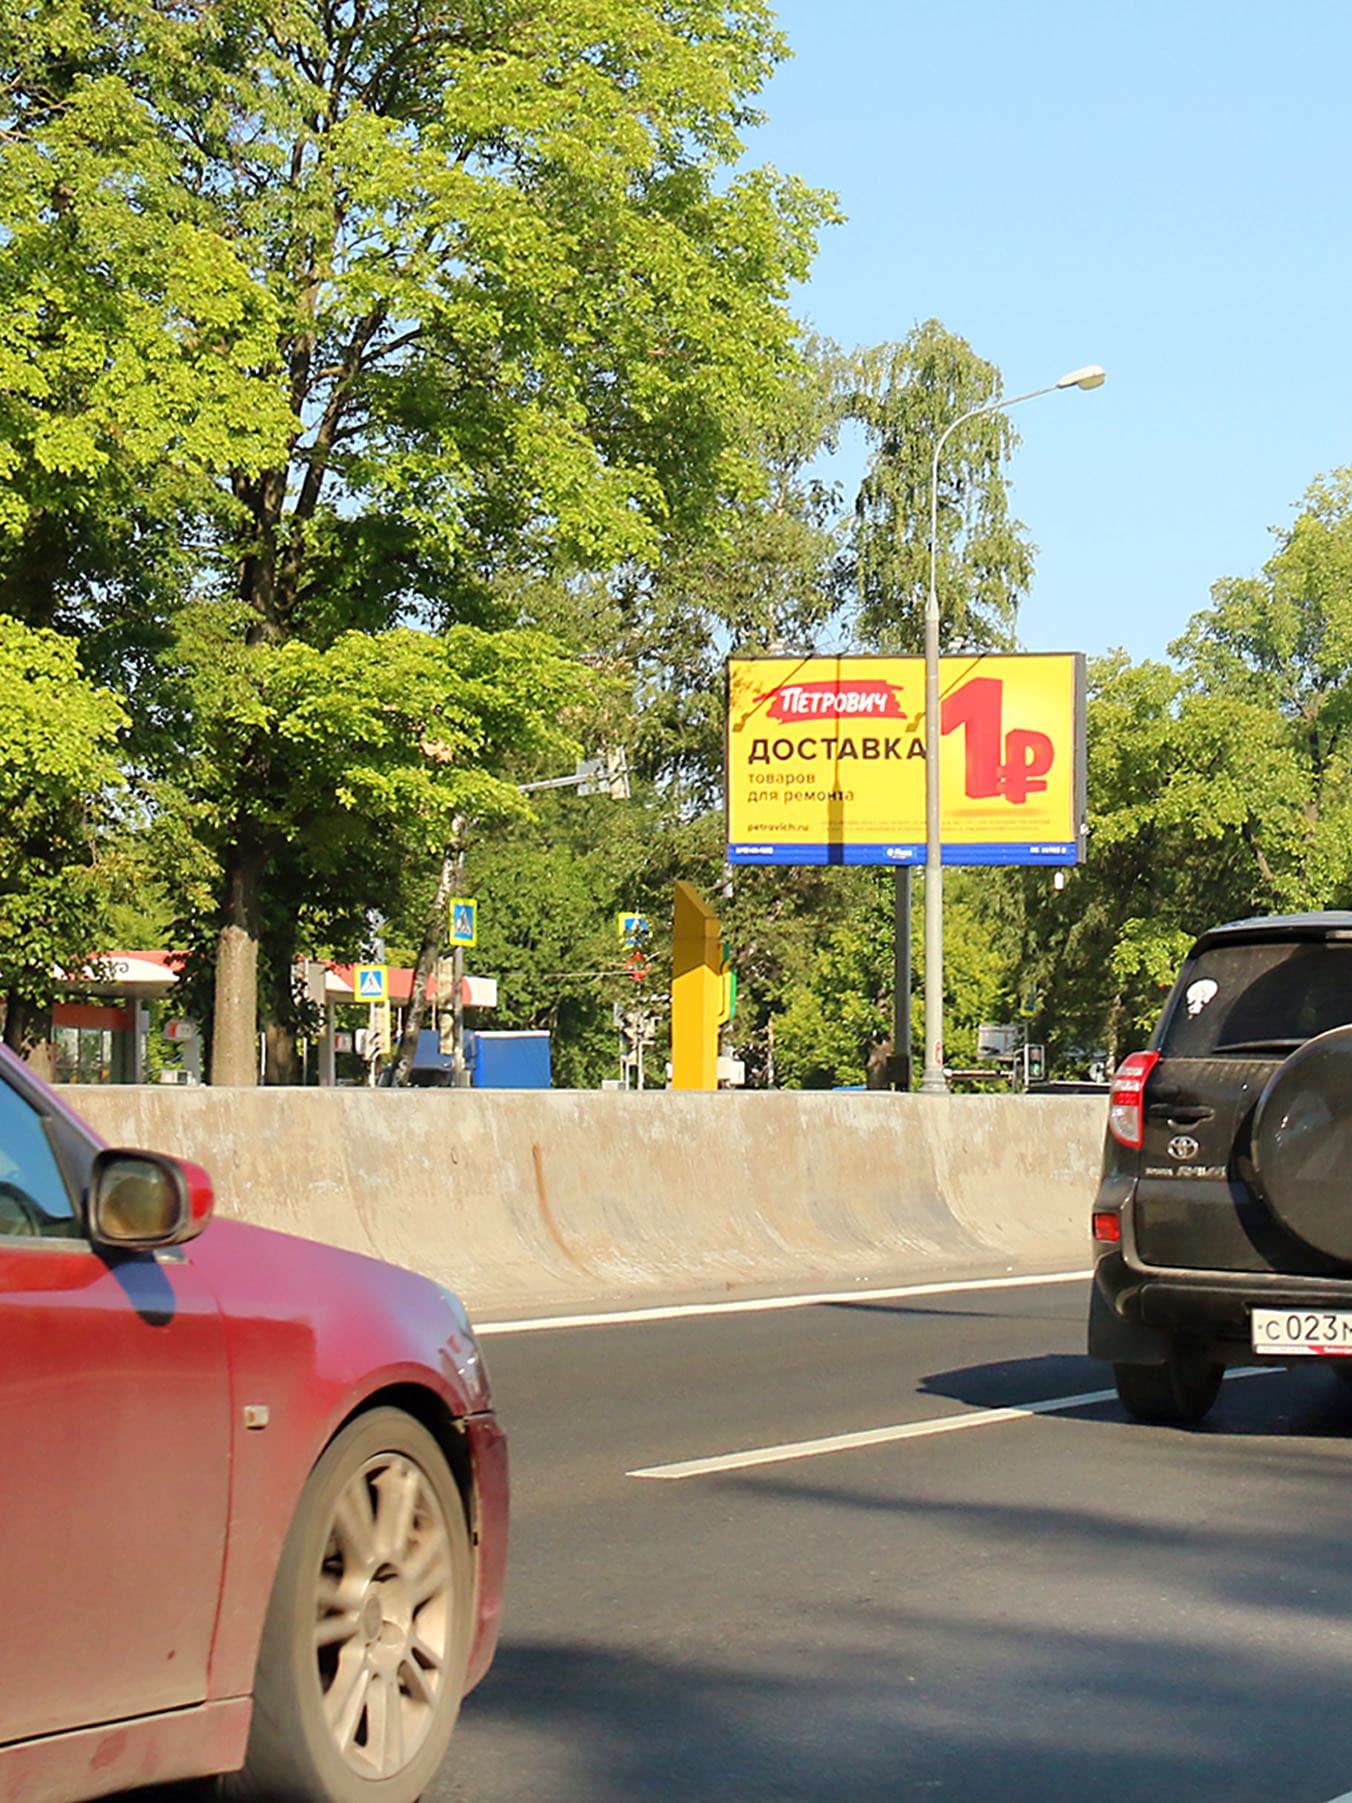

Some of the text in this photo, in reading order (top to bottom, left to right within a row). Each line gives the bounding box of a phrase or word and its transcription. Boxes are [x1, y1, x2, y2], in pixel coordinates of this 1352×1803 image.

[748, 737, 927, 765] ДОСТАВКА
[748, 773, 816, 785] товаров
[747, 790, 855, 804] для ремонта
